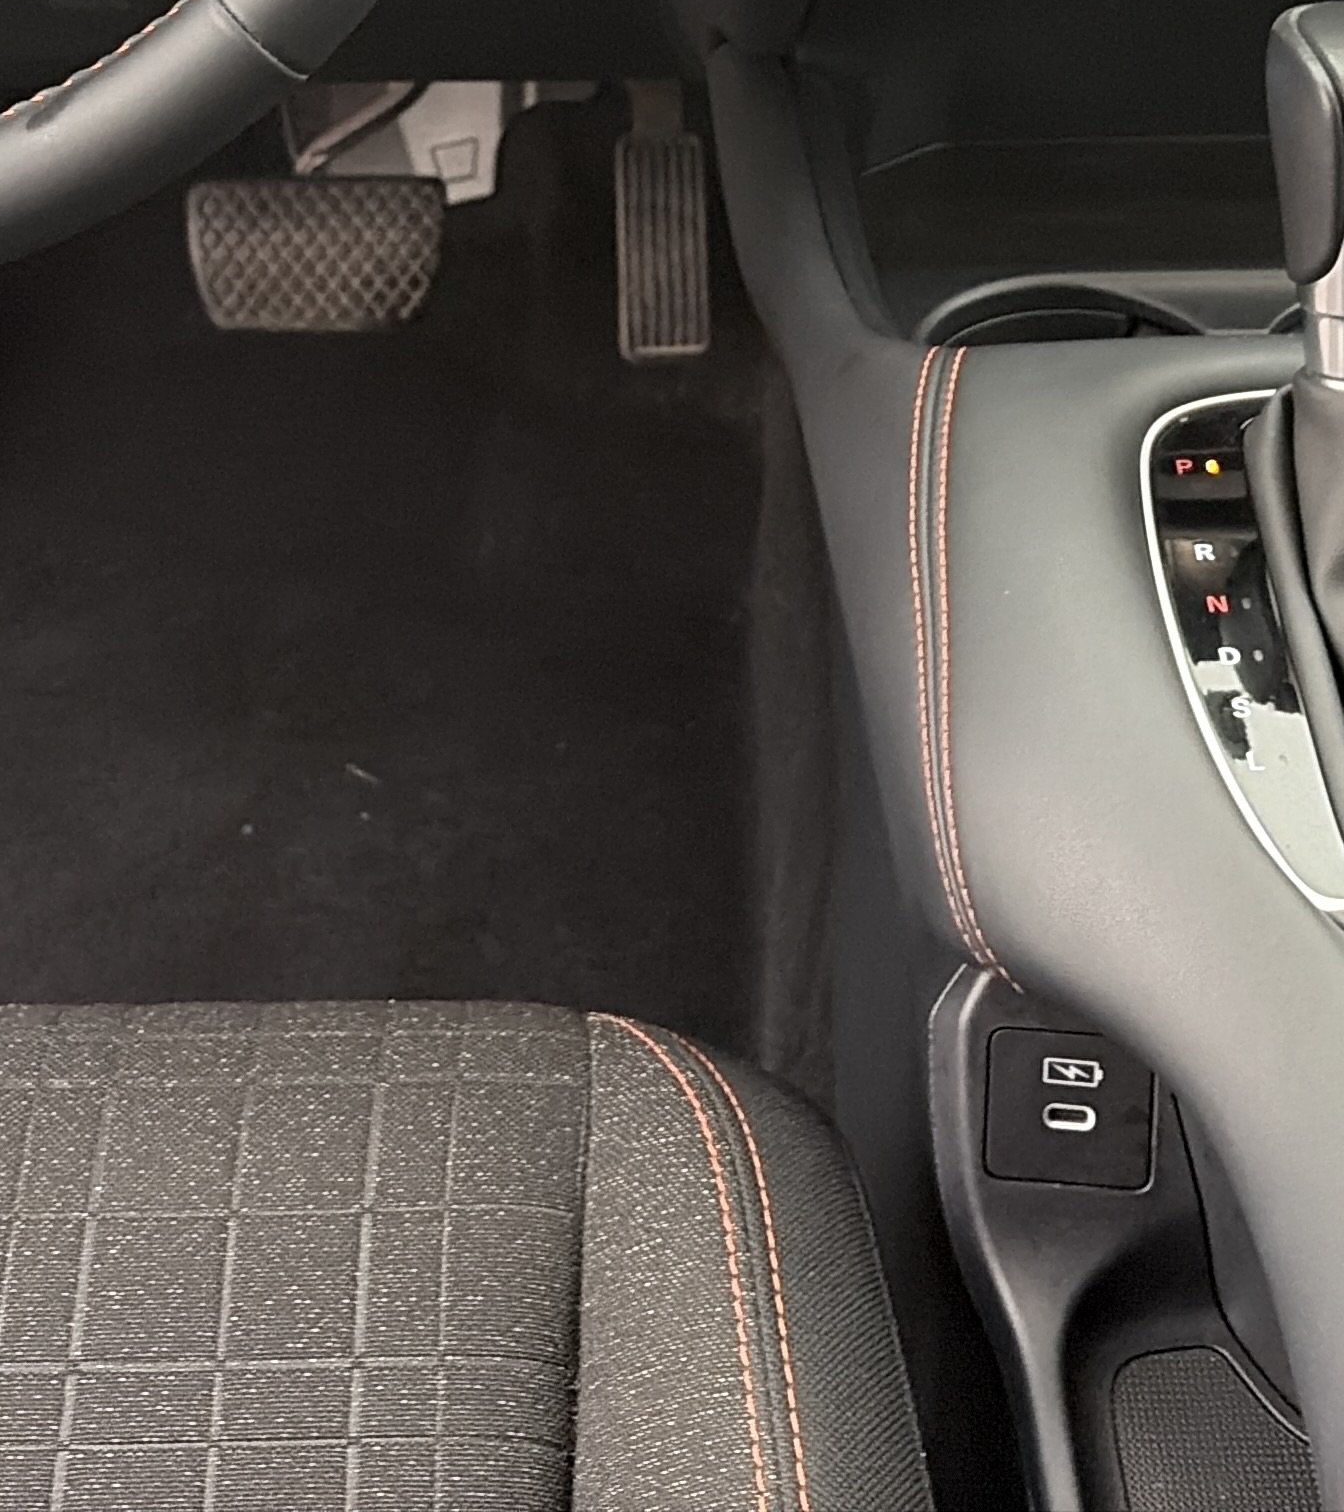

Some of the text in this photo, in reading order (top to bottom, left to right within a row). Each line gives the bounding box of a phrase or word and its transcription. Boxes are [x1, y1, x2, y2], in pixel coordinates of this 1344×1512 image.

[1175, 458, 1194, 475] P
[1193, 543, 1216, 562] R
[1206, 595, 1230, 613] N
[1217, 646, 1242, 666] D
[1230, 696, 1253, 719] S
[1245, 751, 1266, 772] L
